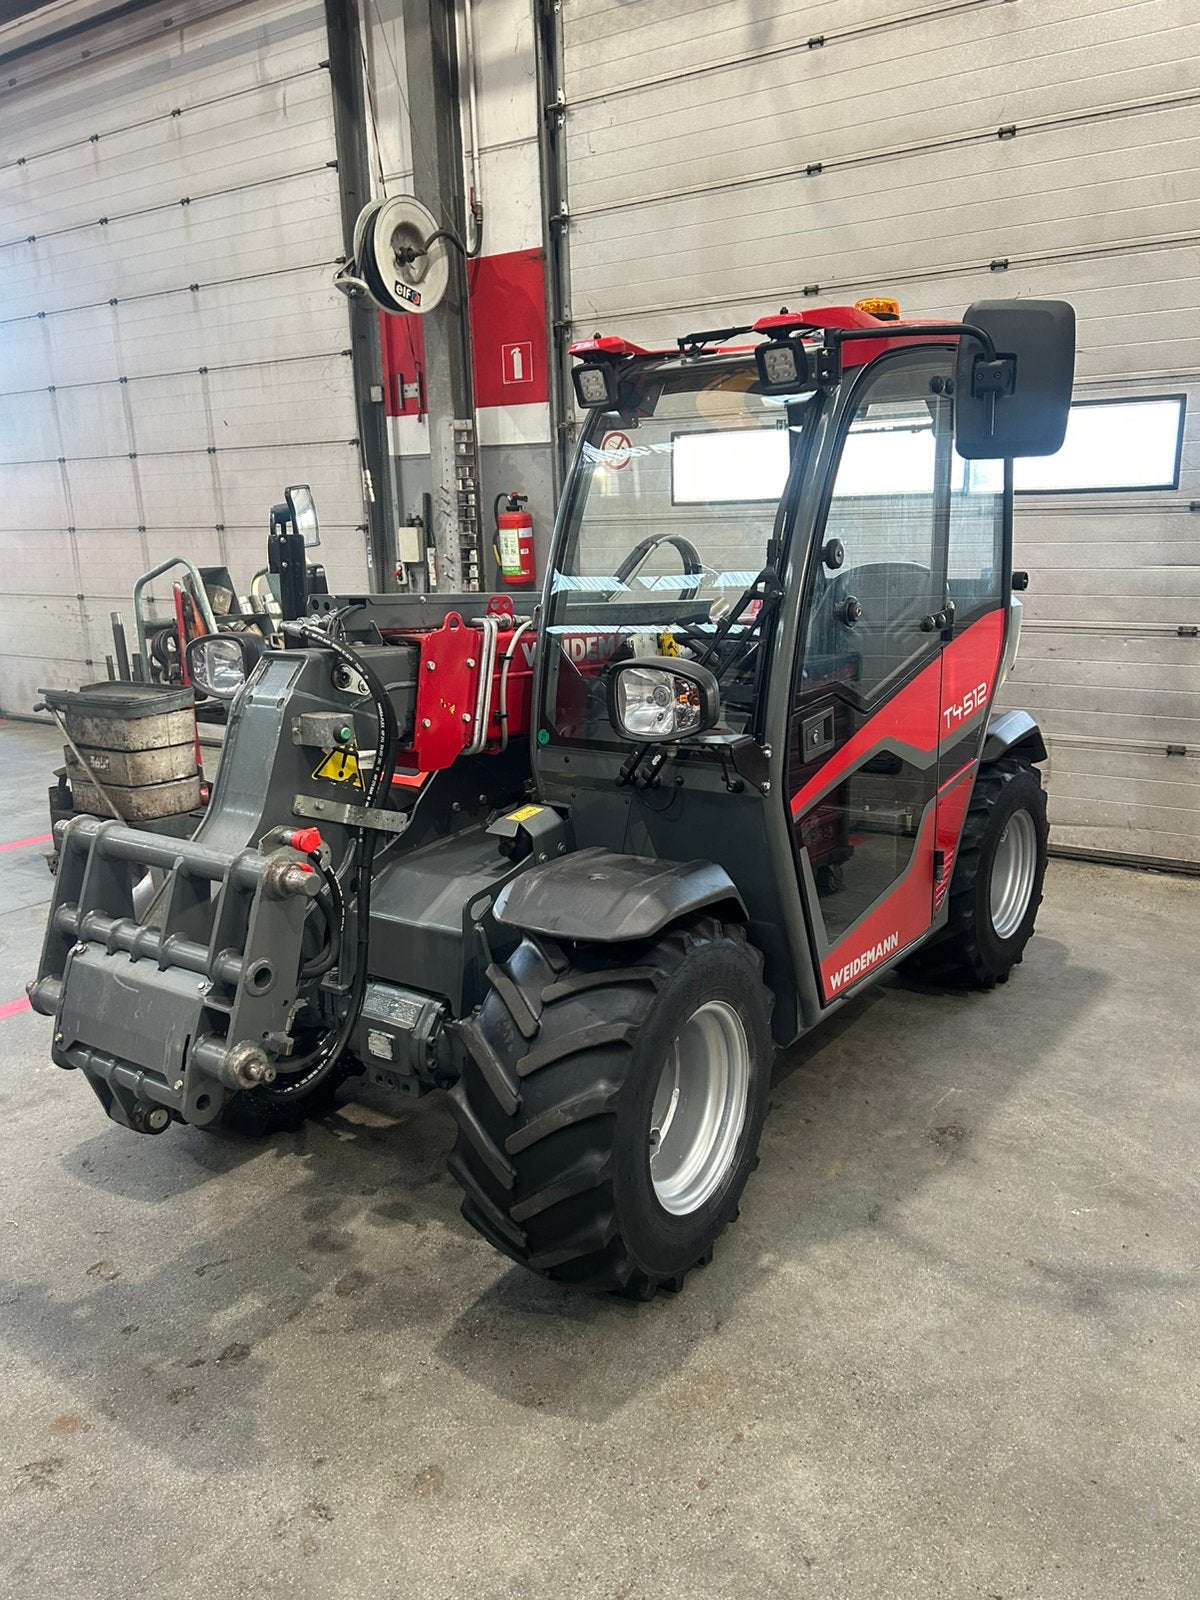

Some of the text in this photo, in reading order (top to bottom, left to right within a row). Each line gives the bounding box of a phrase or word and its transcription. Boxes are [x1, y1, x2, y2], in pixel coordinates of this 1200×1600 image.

[396, 284, 411, 299] elf
[943, 682, 987, 729] T4512
[829, 931, 899, 991] WEIDEMANN
